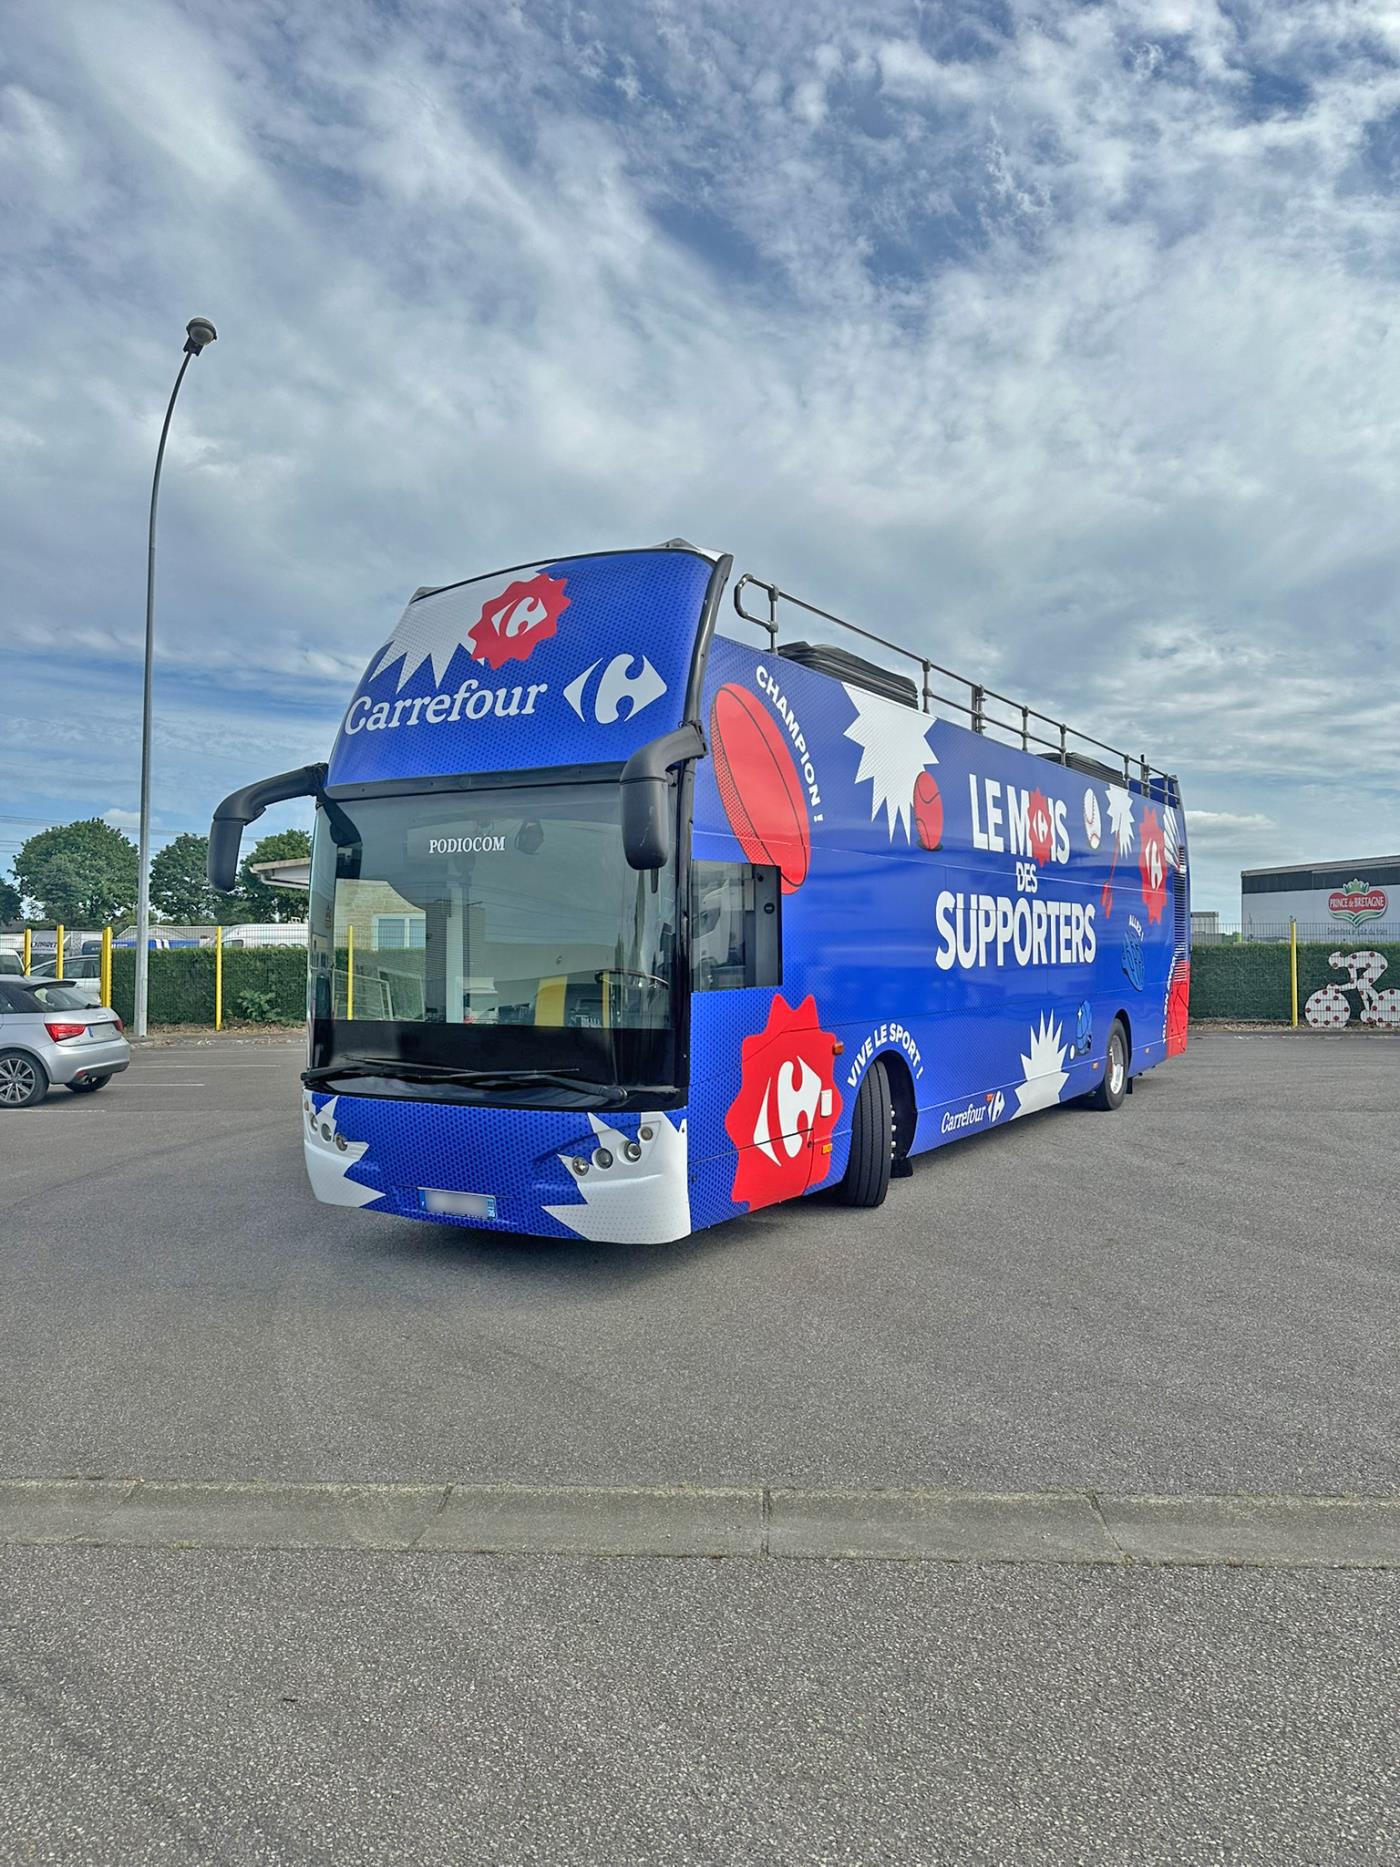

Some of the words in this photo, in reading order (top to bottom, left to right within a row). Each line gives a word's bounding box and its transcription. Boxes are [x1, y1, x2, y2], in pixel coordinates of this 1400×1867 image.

[344, 679, 548, 736] Carrefour
[756, 665, 821, 806] CHAMPION
[813, 813, 824, 823] !
[429, 836, 505, 854] PODIOCOM
[969, 773, 1004, 852] LE
[1006, 785, 1070, 864] MIS
[1015, 861, 1038, 893] DES
[935, 890, 1096, 971] SUPPORTERS
[847, 1036, 873, 1087] VIVE
[874, 1024, 887, 1048] LE
[889, 1023, 921, 1067] SPORT
[916, 1066, 924, 1080] !
[941, 1104, 986, 1134] Carrefour
